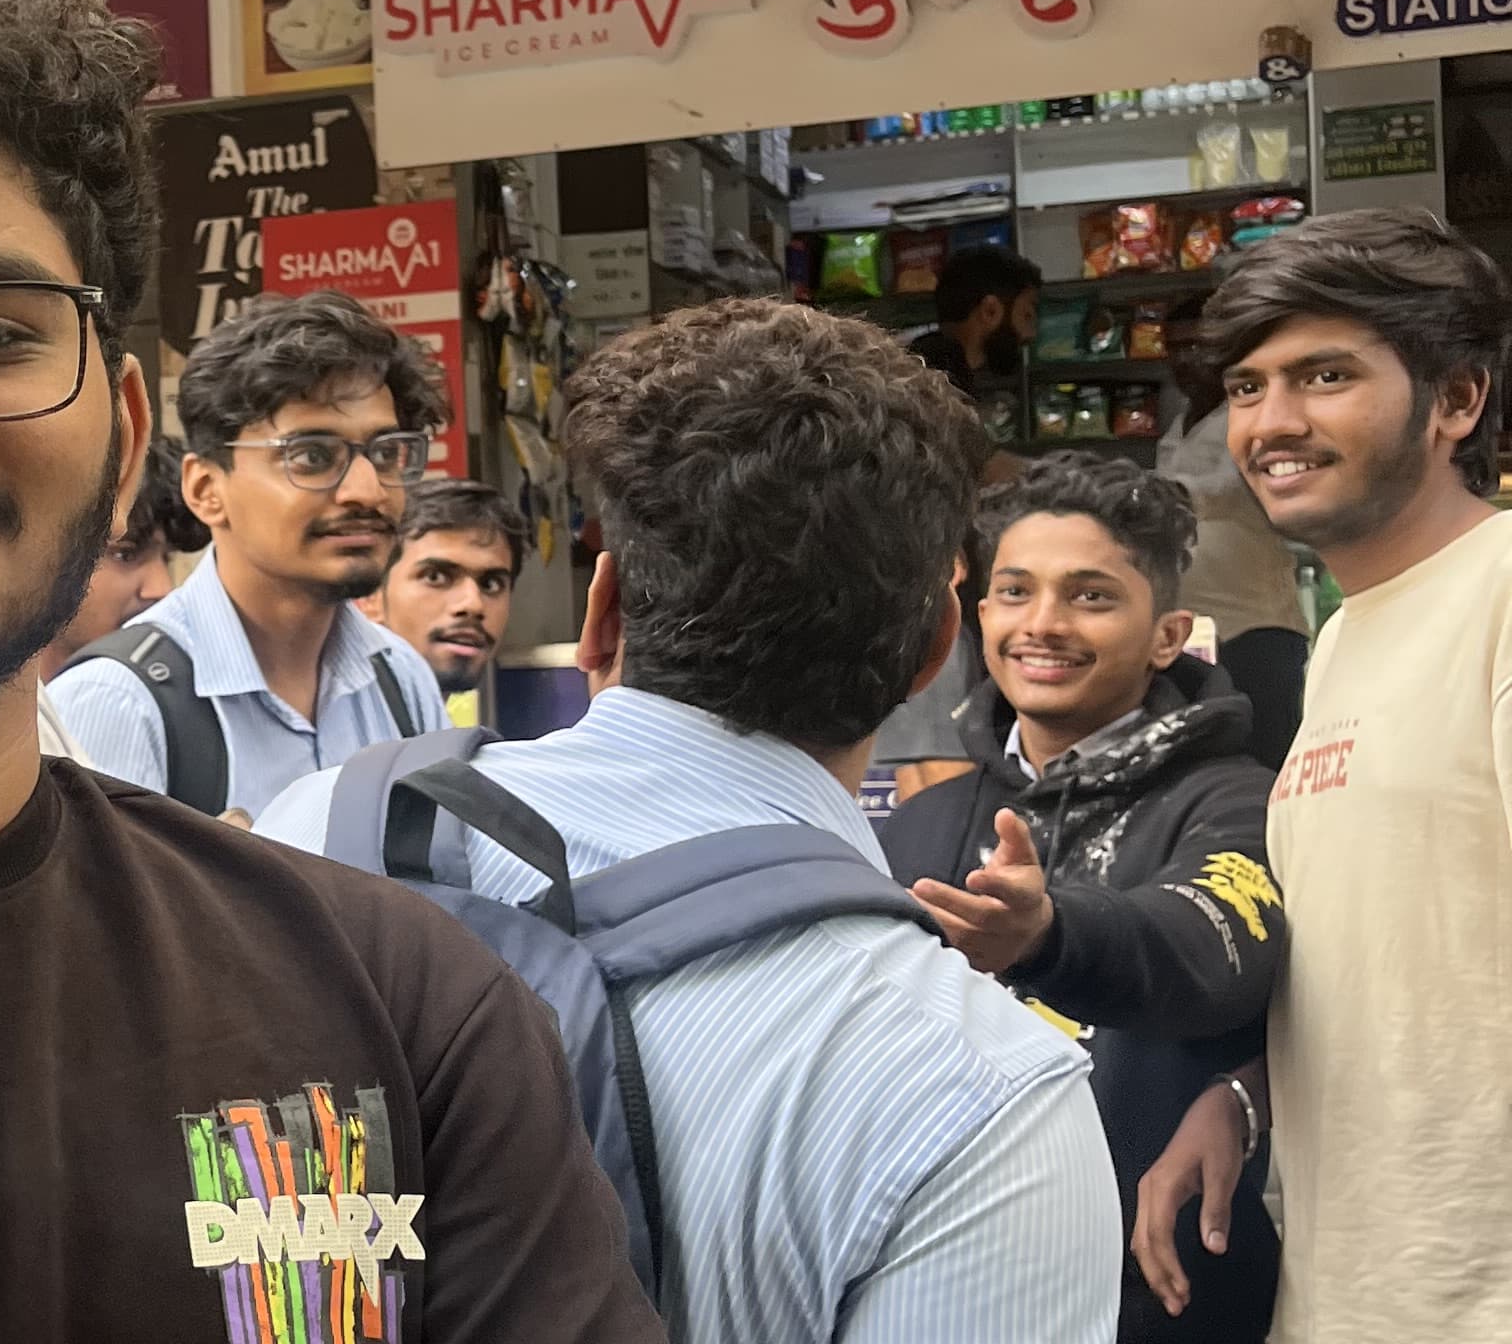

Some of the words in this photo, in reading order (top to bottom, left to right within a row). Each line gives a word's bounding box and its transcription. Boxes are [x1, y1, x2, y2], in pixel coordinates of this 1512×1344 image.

[505, 28, 609, 57] CREAM
[208, 126, 328, 182] Amul
[247, 186, 309, 219] The
[194, 217, 264, 274] Ta
[1295, 739, 1355, 797] PIECE
[184, 1193, 426, 1308] DMARX
